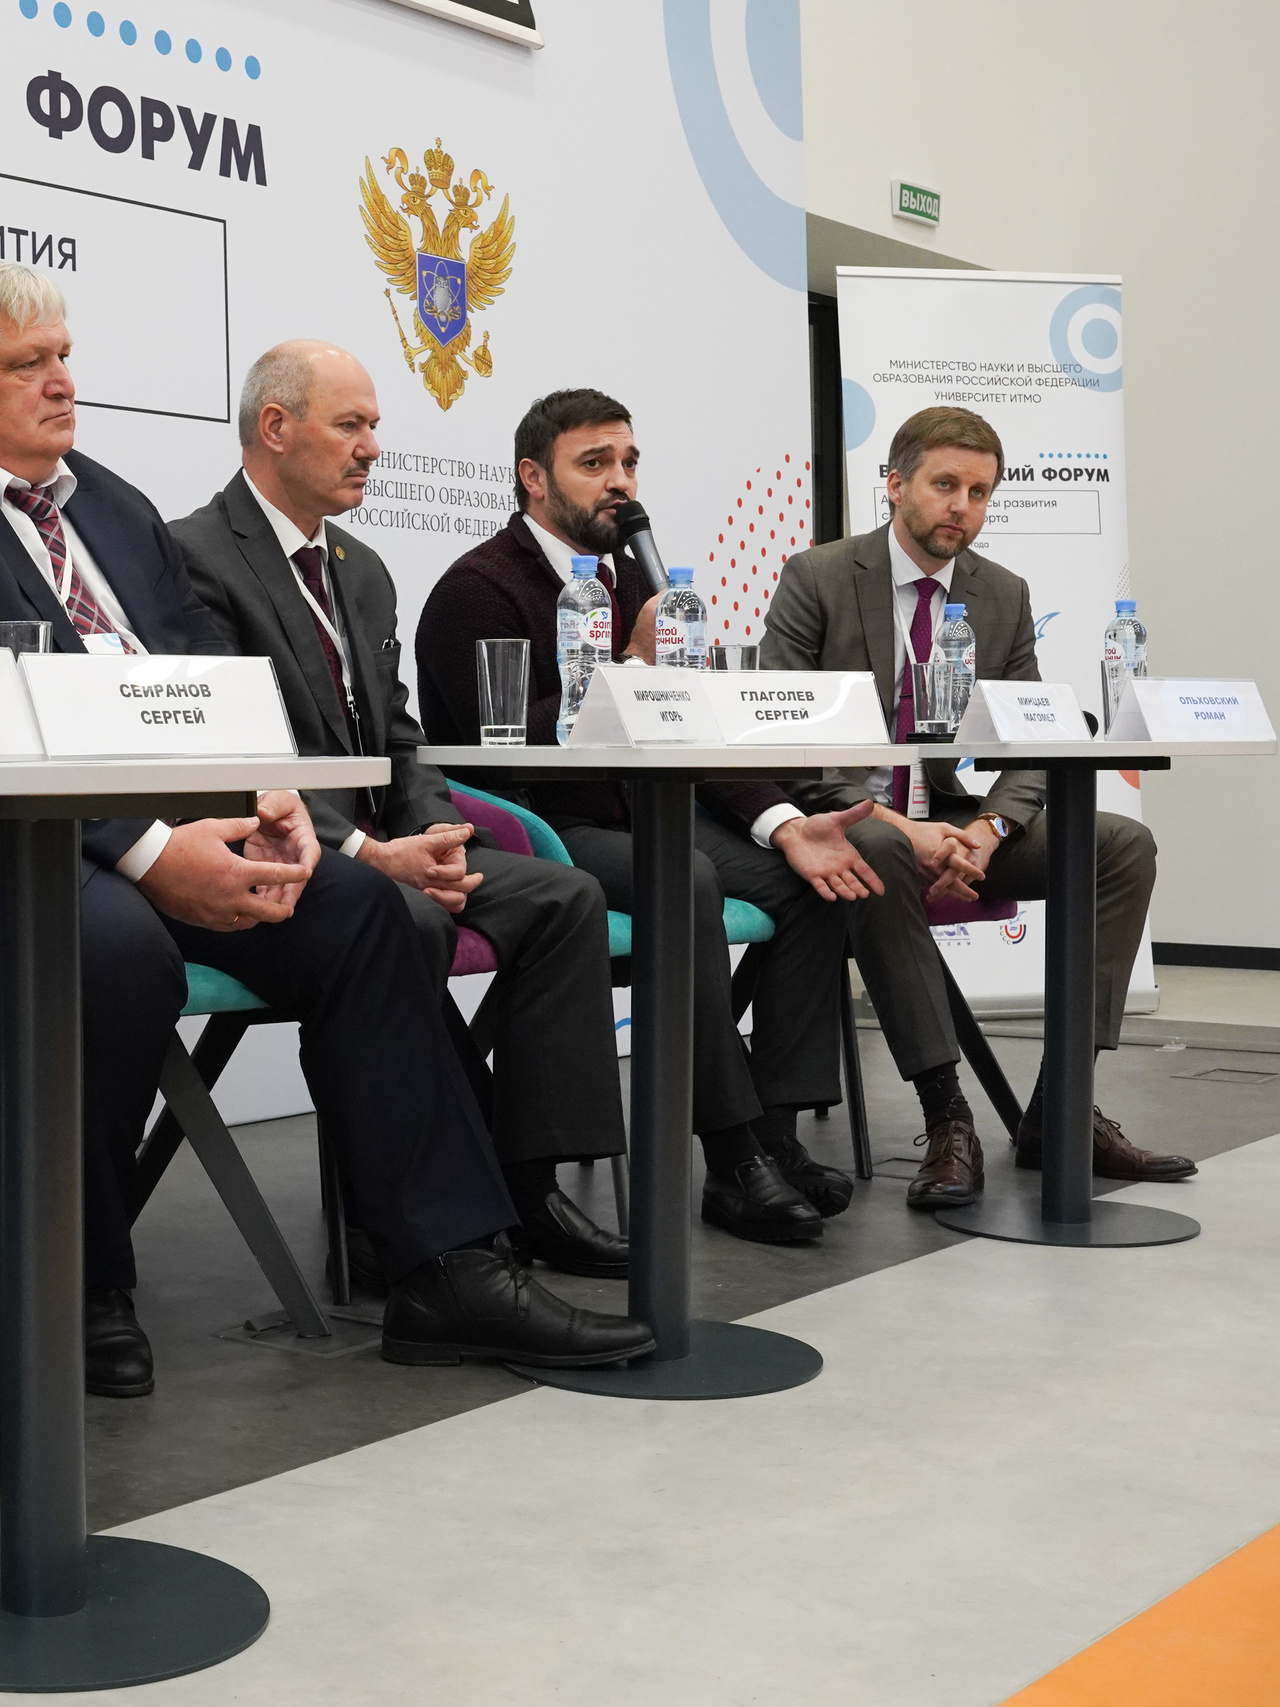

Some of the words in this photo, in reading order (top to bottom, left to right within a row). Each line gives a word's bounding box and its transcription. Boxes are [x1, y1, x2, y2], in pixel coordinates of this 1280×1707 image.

[25, 69, 269, 188] ФОРУМ
[901, 188, 940, 219] ВЫХОД
[889, 359, 977, 372] МИНИСТЕРСТВО
[979, 363, 1015, 373] НАУКИ
[1017, 363, 1025, 373] И
[1027, 363, 1083, 374] ВЫСШЕГО
[872, 372, 954, 385] ОБРАЗОВАНИЯ
[955, 375, 1033, 387] РОССИЙСКОЙ
[1035, 377, 1101, 389] ФЕДЕРАЦИИ
[934, 391, 1007, 403] УНИВЕРСИТЕТ
[1010, 393, 1042, 404] ИТМО
[1041, 467, 1110, 483] ФОРУМ
[364, 478, 436, 503] ВЫСШЕГО
[1003, 499, 1058, 510] развития
[349, 506, 451, 533] РОССИЙСКОЙ
[633, 690, 691, 702] МИРОШНИЧЕНКО
[740, 690, 815, 702] ГЛАГОЛЕВ
[1179, 695, 1240, 705] ОЛЬХОВСКИЙ
[140, 706, 206, 725] СЕРГЕЙ
[659, 710, 684, 722] ИГОРЬ
[754, 707, 810, 721] СЕРГЕЙ
[1194, 711, 1226, 720] РОМАН
